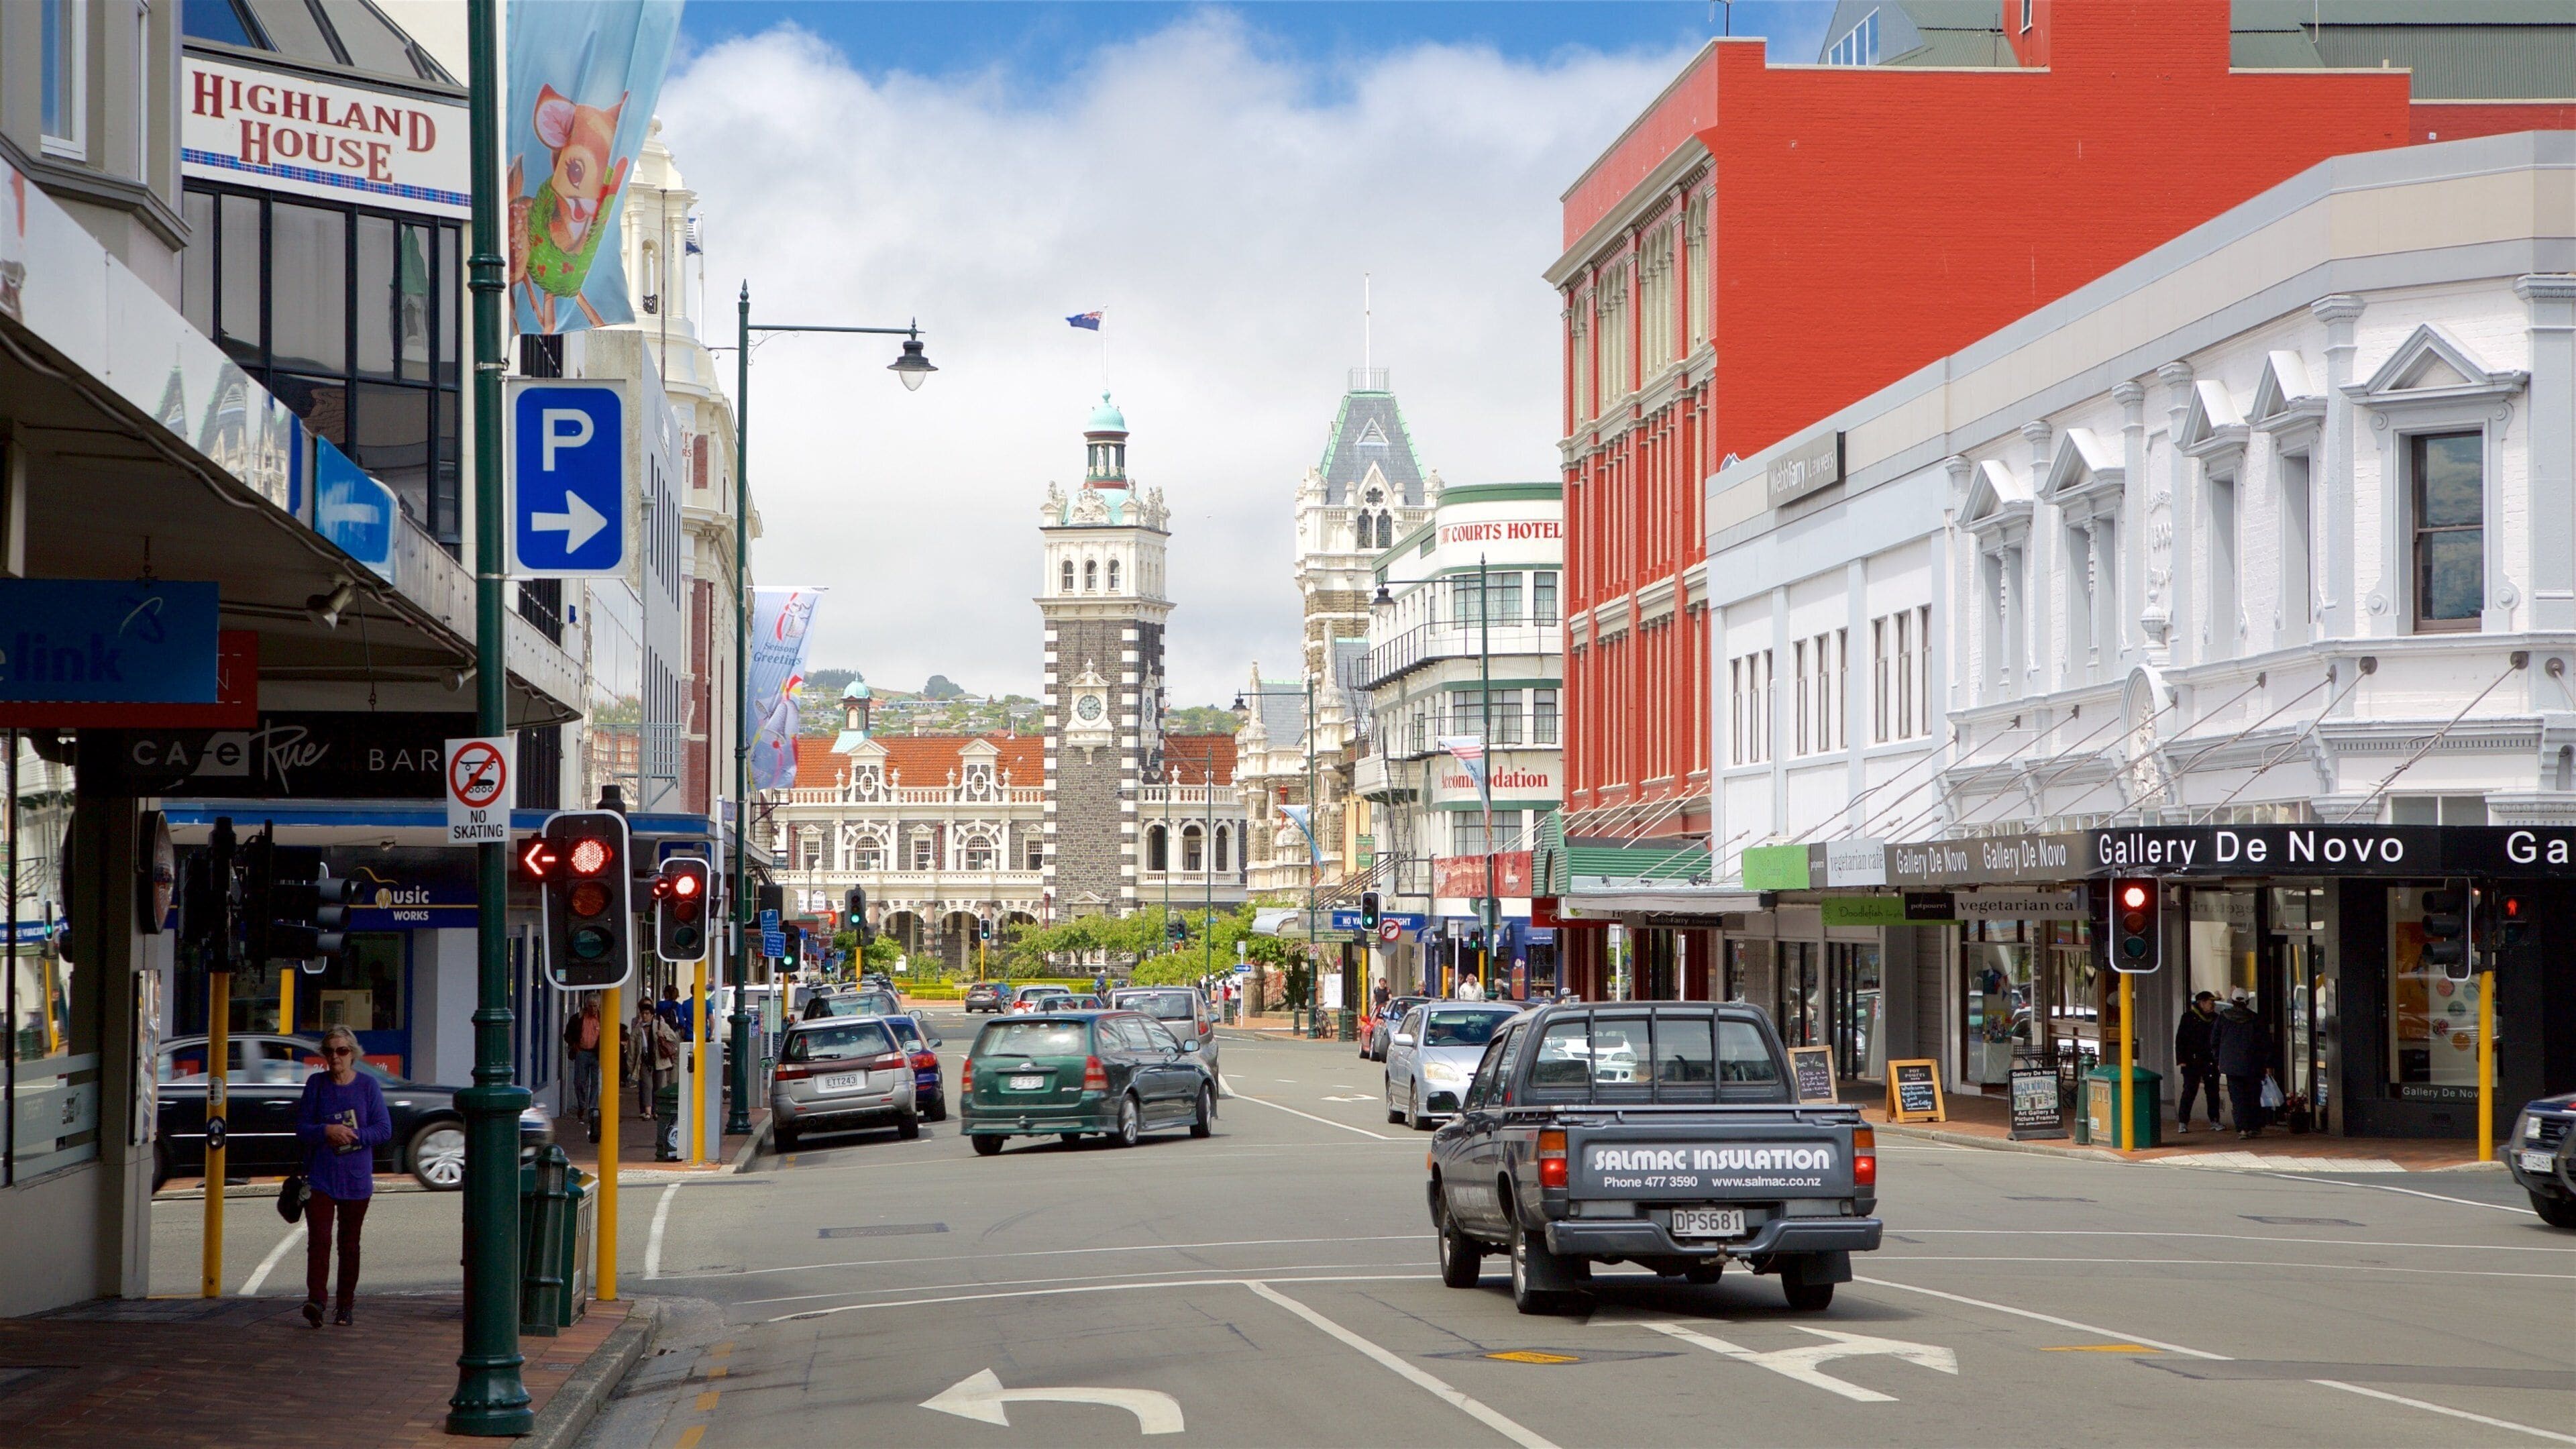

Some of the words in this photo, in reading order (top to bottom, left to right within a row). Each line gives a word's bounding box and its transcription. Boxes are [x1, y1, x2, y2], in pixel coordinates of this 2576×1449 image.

[192, 70, 437, 154] HIGHLAND
[239, 119, 394, 184] HOUSE
[542, 408, 594, 472] P
[1452, 523, 1502, 543] COURTS
[1507, 522, 1563, 539] HOTEL
[369, 749, 439, 771] BAR
[1442, 766, 1548, 789] Accomdation
[470, 809, 487, 824] NO
[453, 824, 504, 839] SKATING
[1983, 842, 2019, 875] Gallery
[2021, 840, 2037, 868] De
[2038, 839, 2067, 867] Novo
[2098, 832, 2197, 865] Gallery
[2216, 831, 2268, 863] De
[2288, 830, 2405, 863] Novo
[1829, 850, 1867, 879] vegetarian
[1896, 848, 1927, 879] Gallery
[1929, 847, 1942, 873] De
[1943, 846, 1968, 873] Novo
[393, 910, 429, 922] WORKS
[1960, 899, 2050, 914] vegetarian
[2055, 901, 2074, 912] ca
[826, 1076, 857, 1087] ETT243
[2402, 1086, 2438, 1099] Gallery
[2442, 1088, 2456, 1097] De
[2459, 1088, 2479, 1099] Nov
[1594, 1149, 1686, 1171] SALMAC
[1694, 1148, 1830, 1171] INSULATION
[1604, 1176, 1642, 1187] Phone
[1644, 1176, 1666, 1187] 477
[1669, 1176, 1698, 1187] 3590
[1712, 1175, 1821, 1187] www.salmac.co.nz
[1674, 1213, 1741, 1230] DPS681
